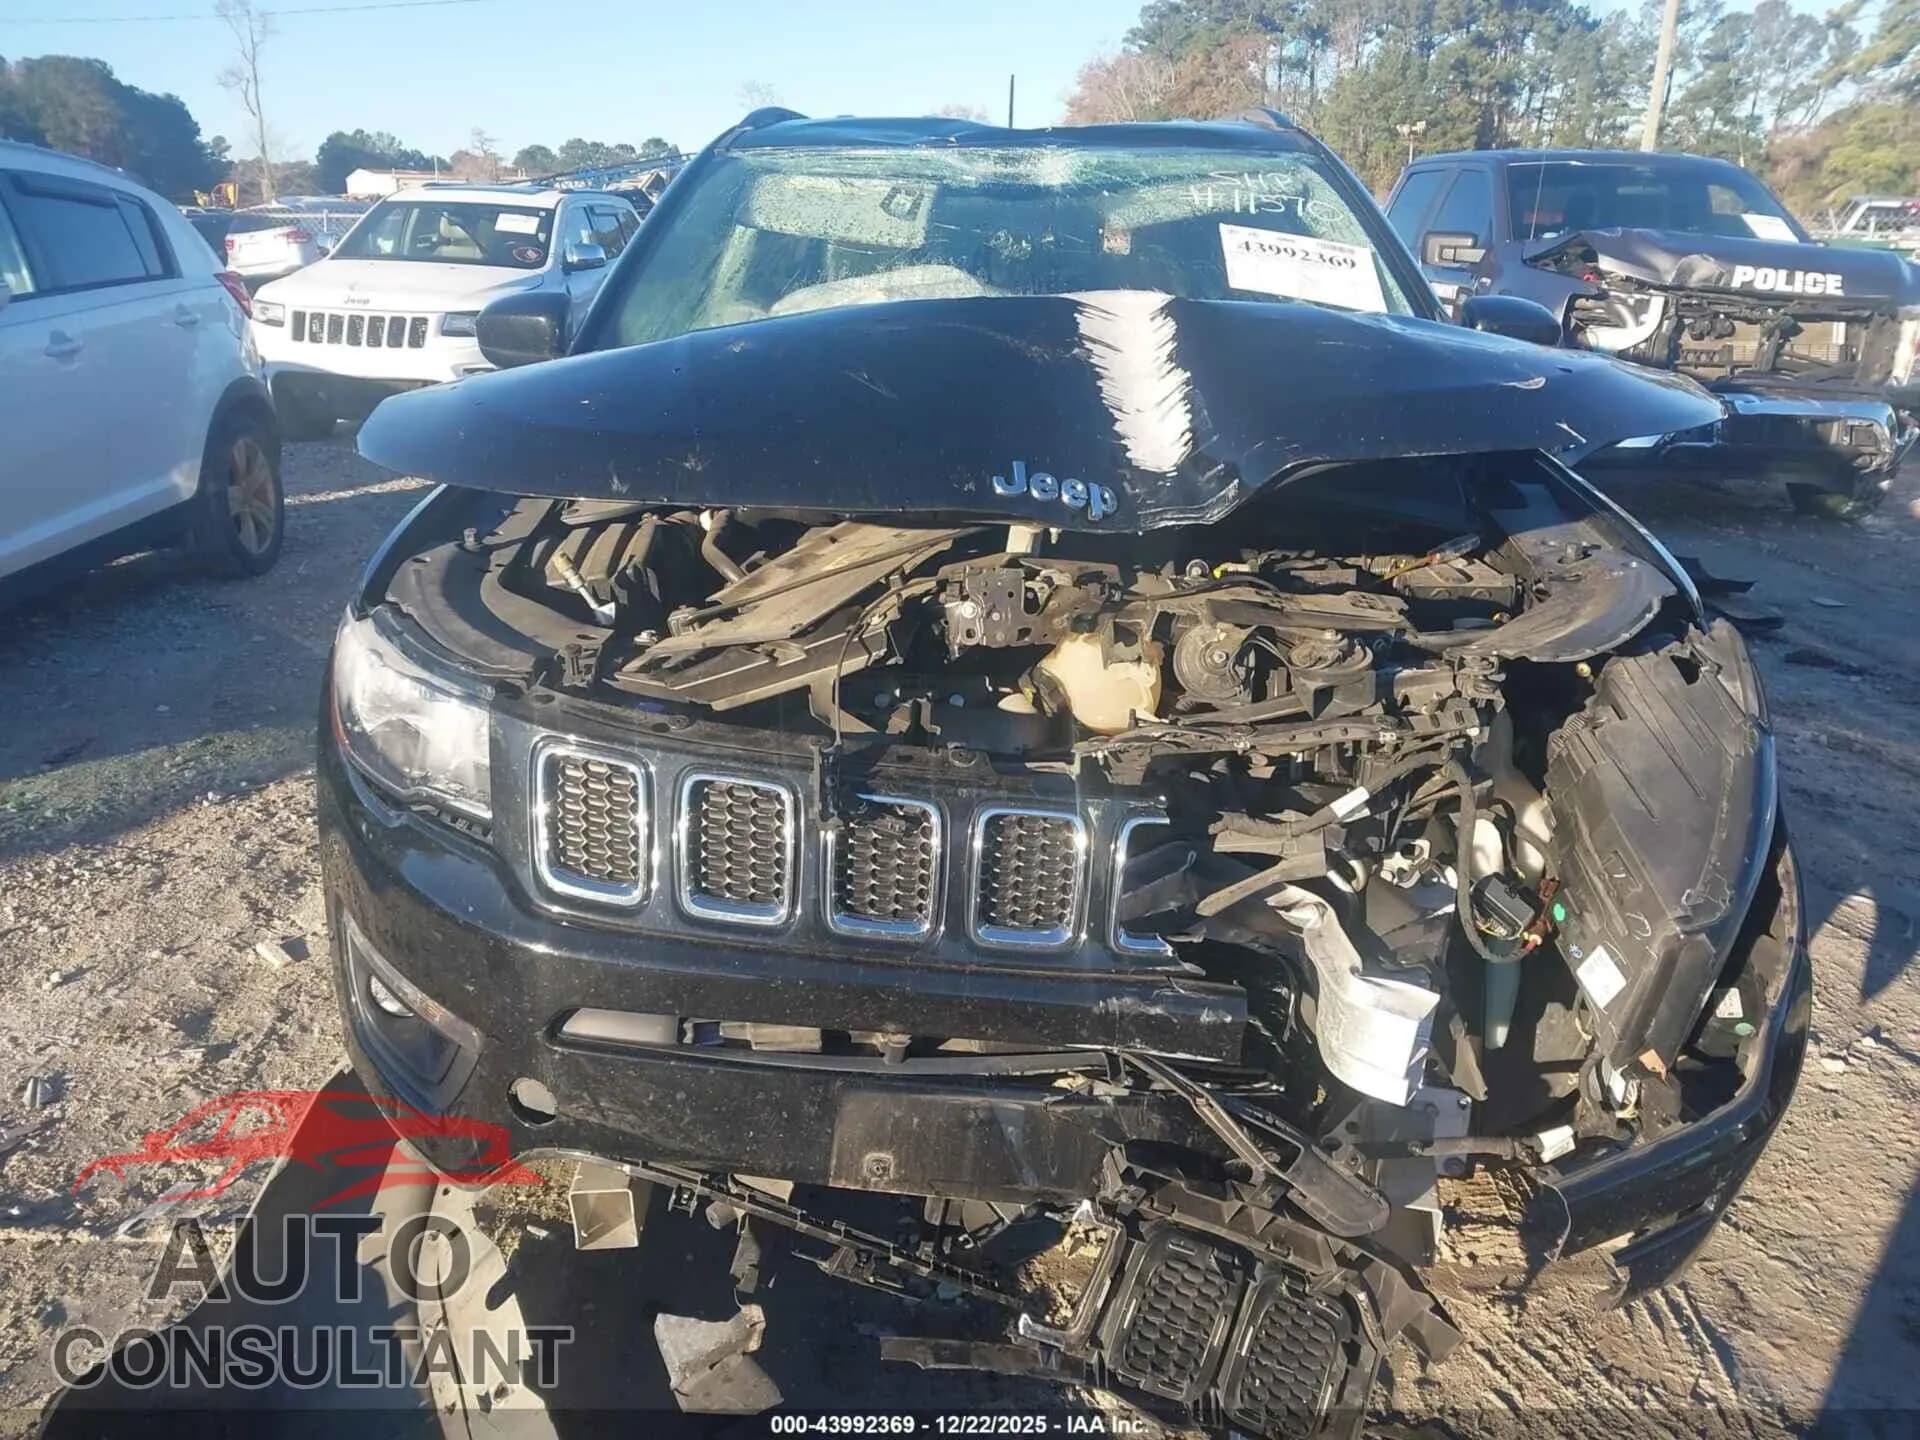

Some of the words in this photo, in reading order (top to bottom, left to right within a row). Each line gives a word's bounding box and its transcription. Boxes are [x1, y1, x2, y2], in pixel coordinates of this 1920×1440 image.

[1237, 239, 1357, 270] 43992369
[1730, 264, 1845, 297] POLICE
[343, 294, 371, 307] Jeep
[992, 460, 1118, 521] Jeep
